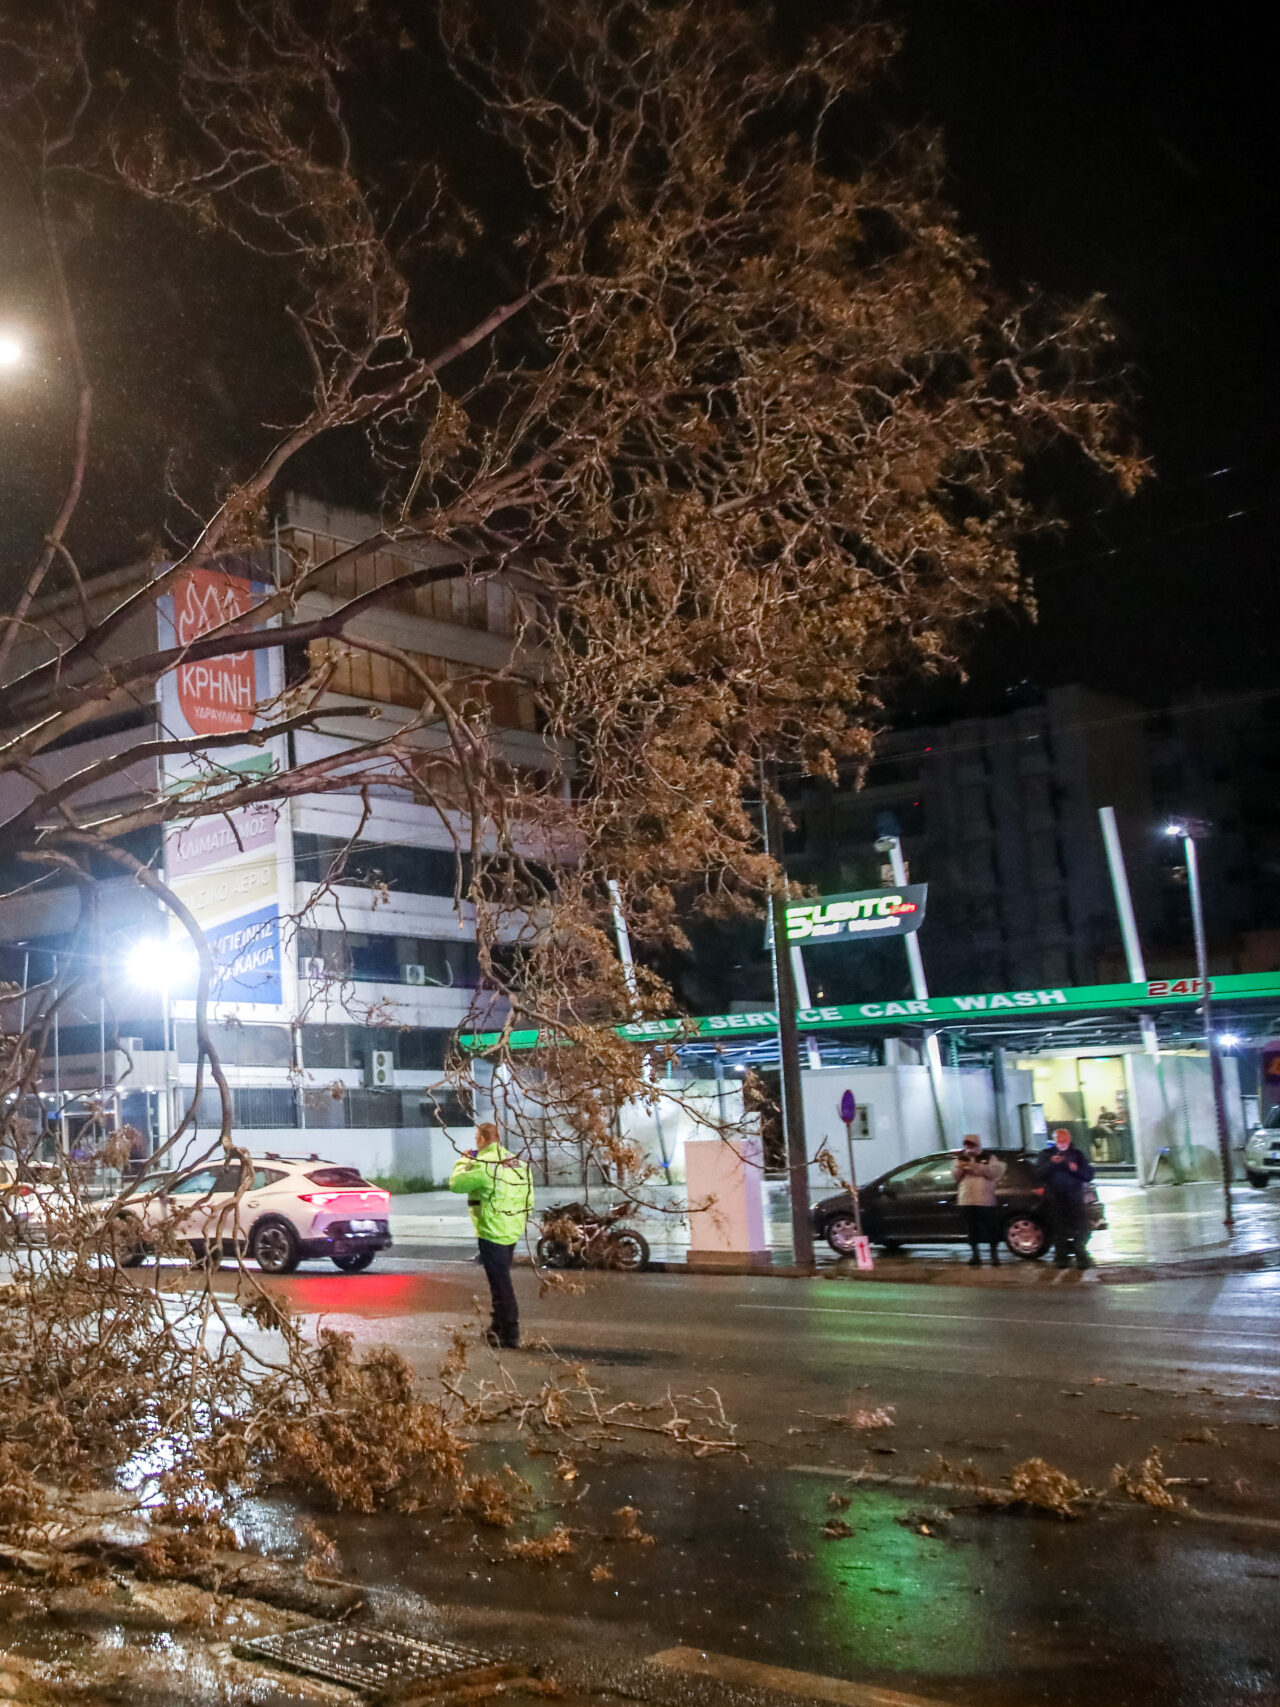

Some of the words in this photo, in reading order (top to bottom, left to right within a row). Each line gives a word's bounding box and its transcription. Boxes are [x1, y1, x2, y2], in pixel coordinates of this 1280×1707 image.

[182, 664, 251, 707] ΚΡΗΝΗ
[860, 1000, 933, 1018] CAR
[953, 990, 1067, 1010] WASH
